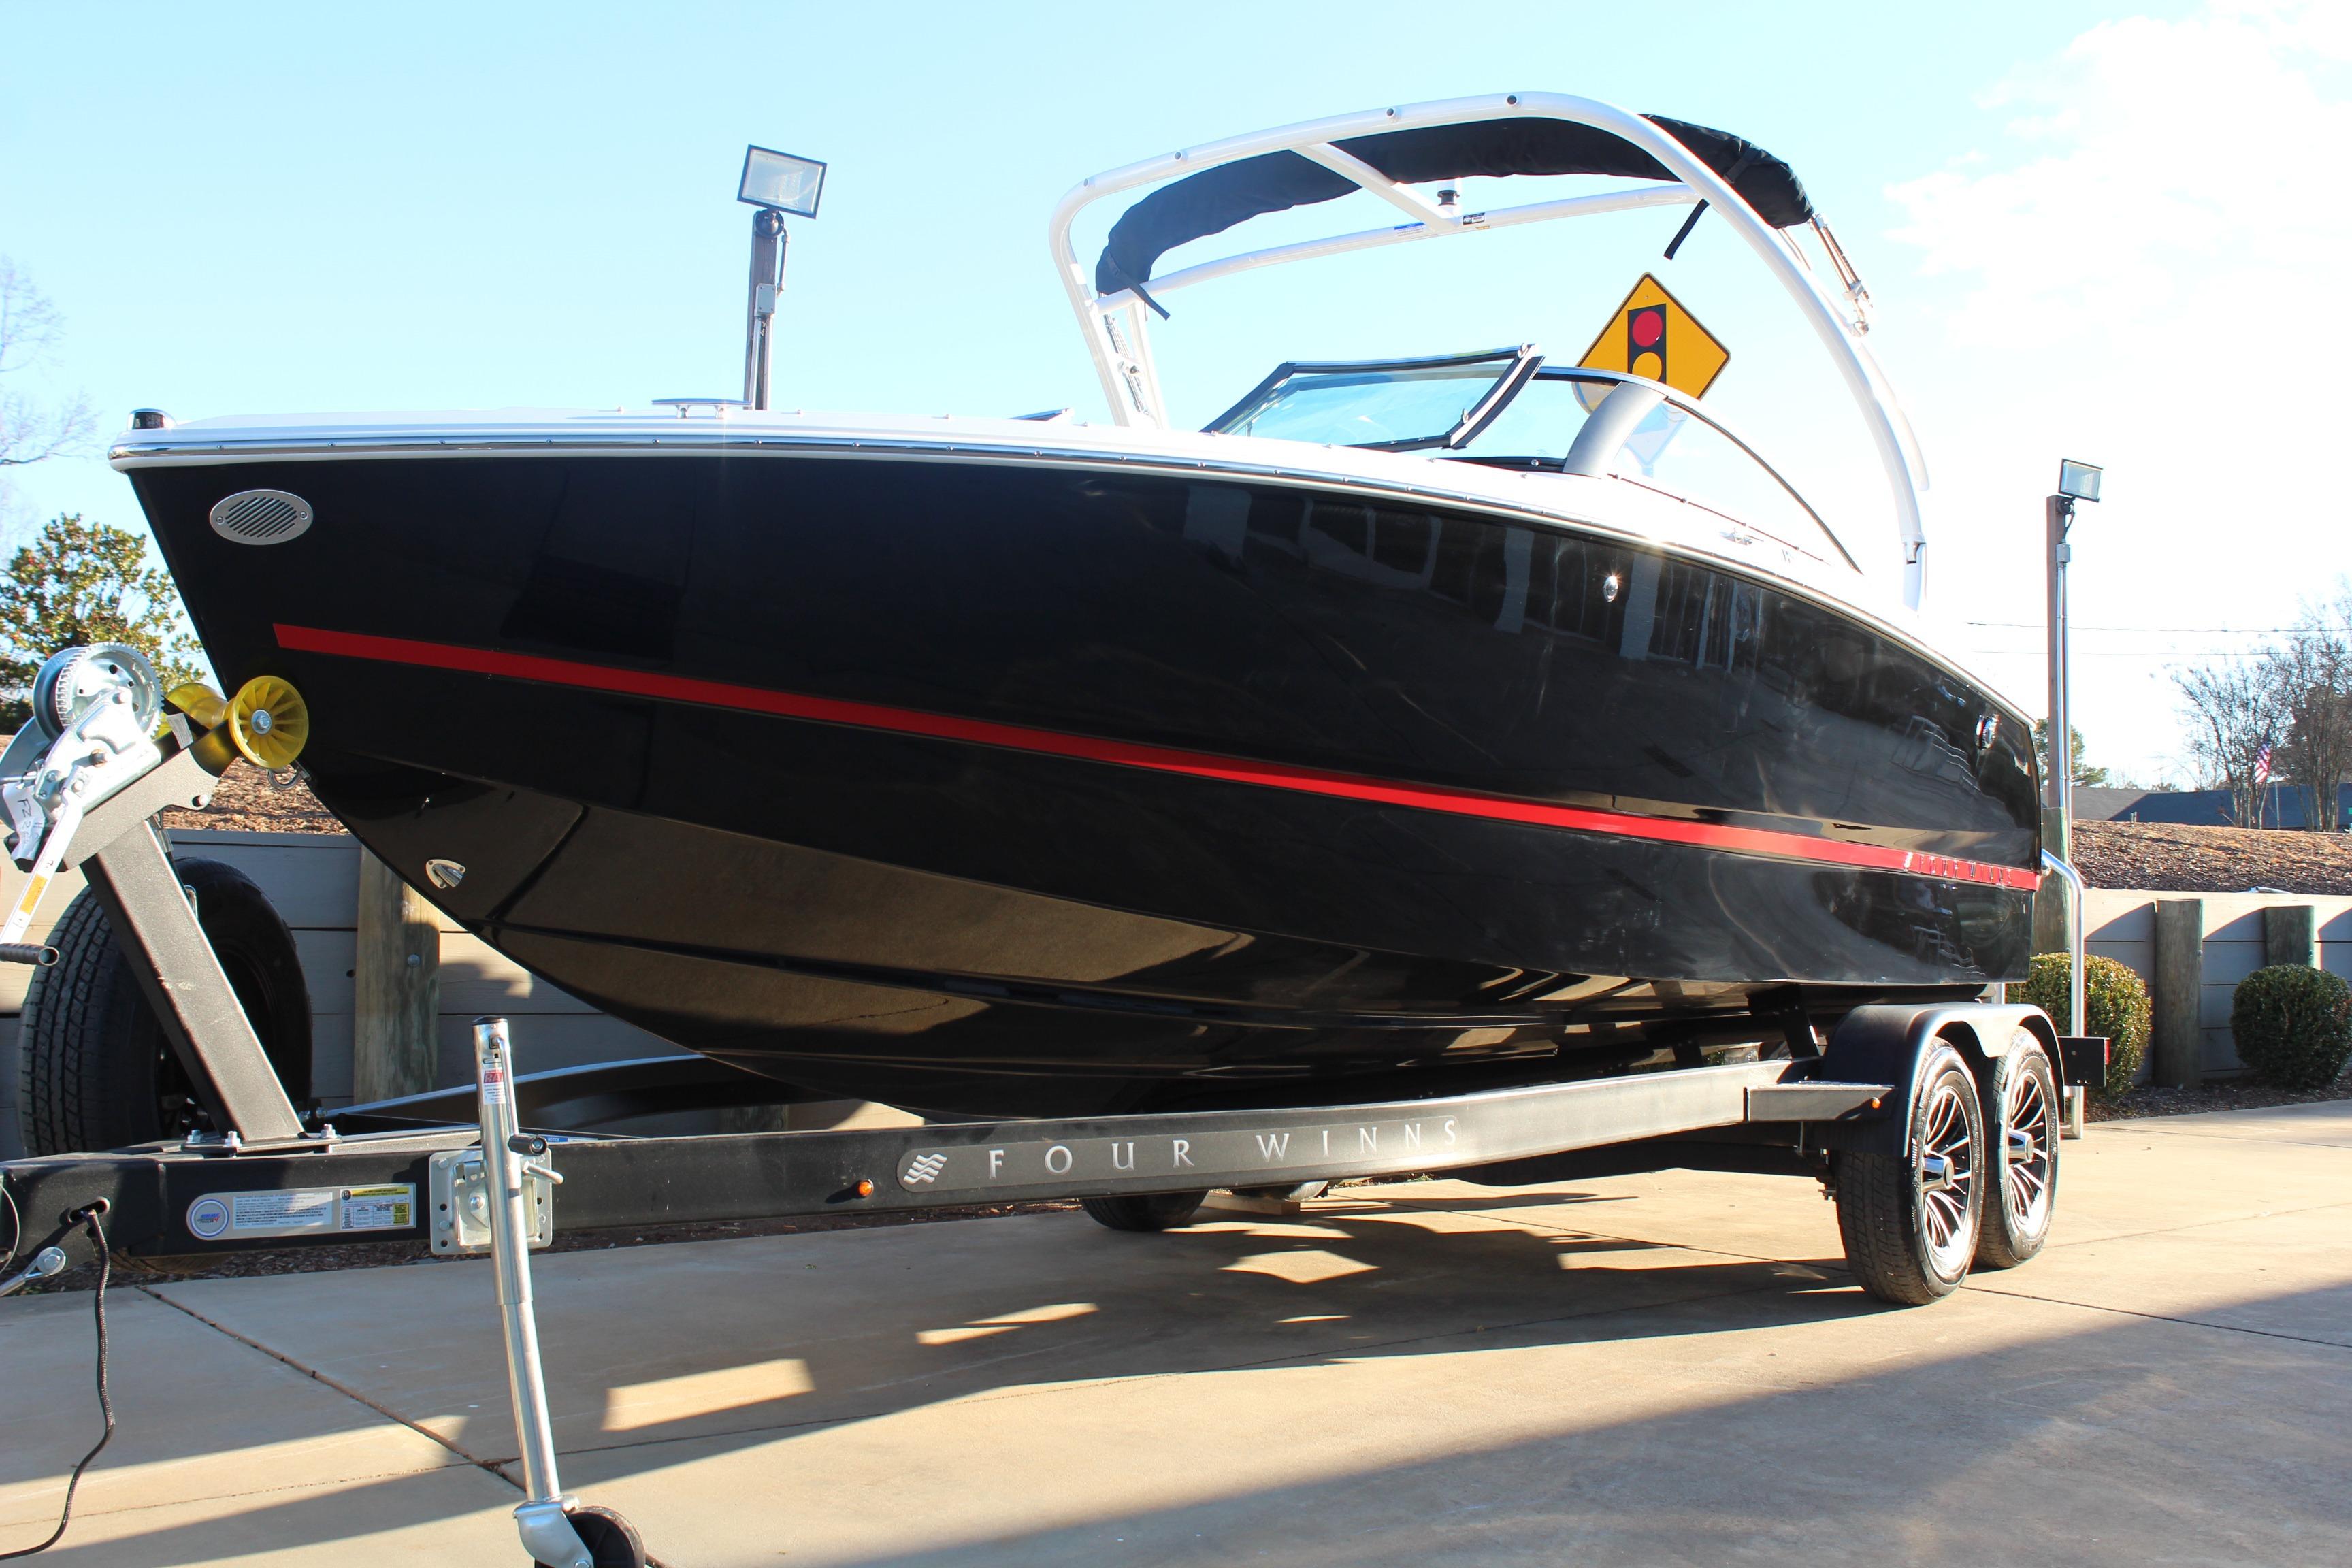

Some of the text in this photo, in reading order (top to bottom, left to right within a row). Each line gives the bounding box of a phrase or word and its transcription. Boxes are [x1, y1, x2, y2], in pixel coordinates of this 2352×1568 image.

[484, 1073, 504, 1083] RA
[988, 1119, 1457, 1180] FOUR WINNS
